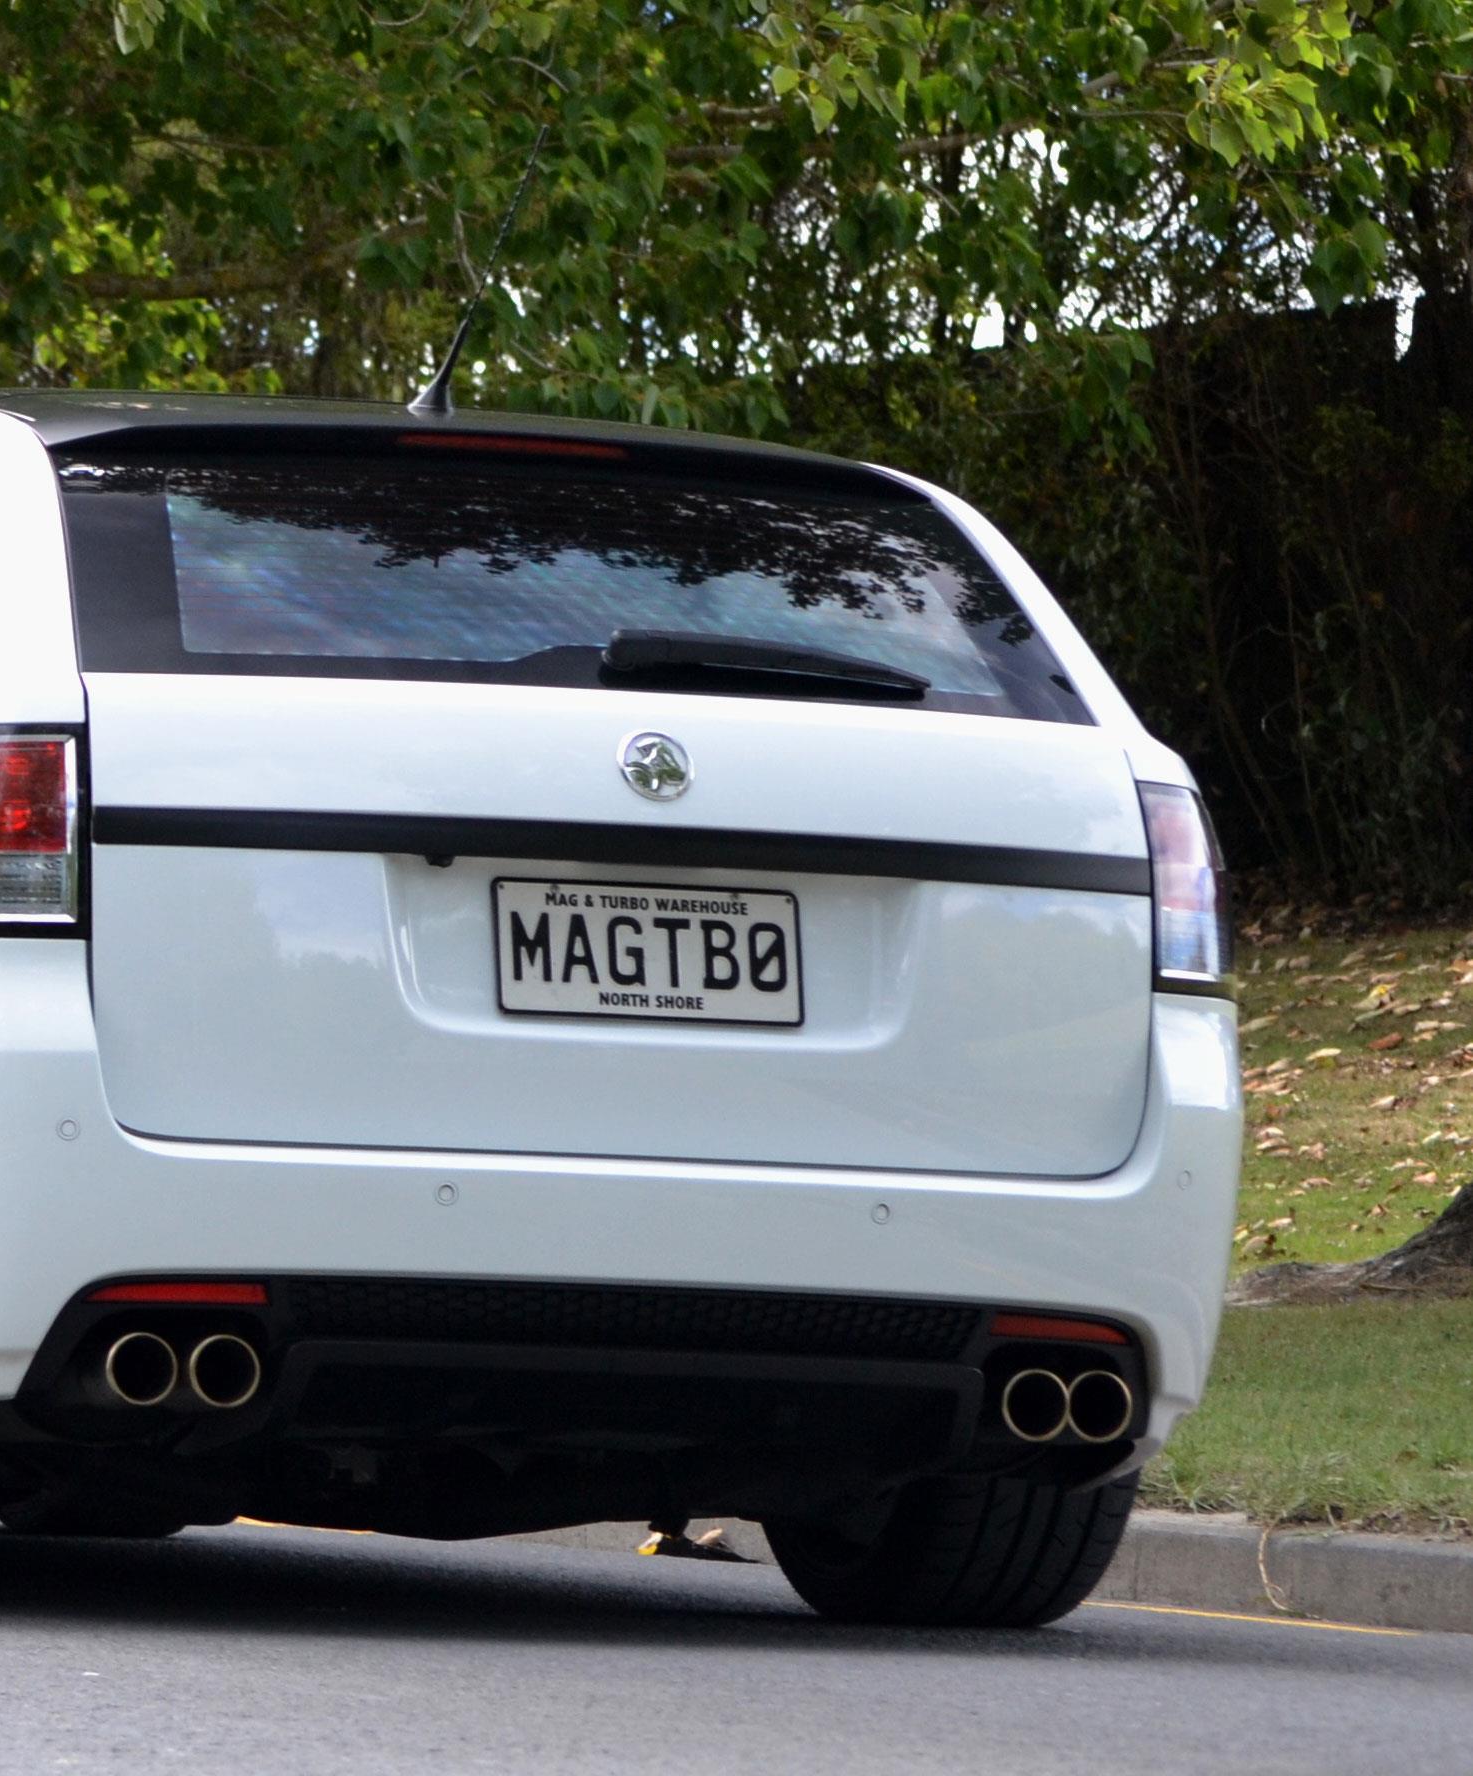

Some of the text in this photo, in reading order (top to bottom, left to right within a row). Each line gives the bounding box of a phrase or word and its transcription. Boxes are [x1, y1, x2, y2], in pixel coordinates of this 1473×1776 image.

[545, 892, 749, 916] MAG & TURBO WAREHOUSE
[598, 992, 704, 1010] NORTH SHORE
